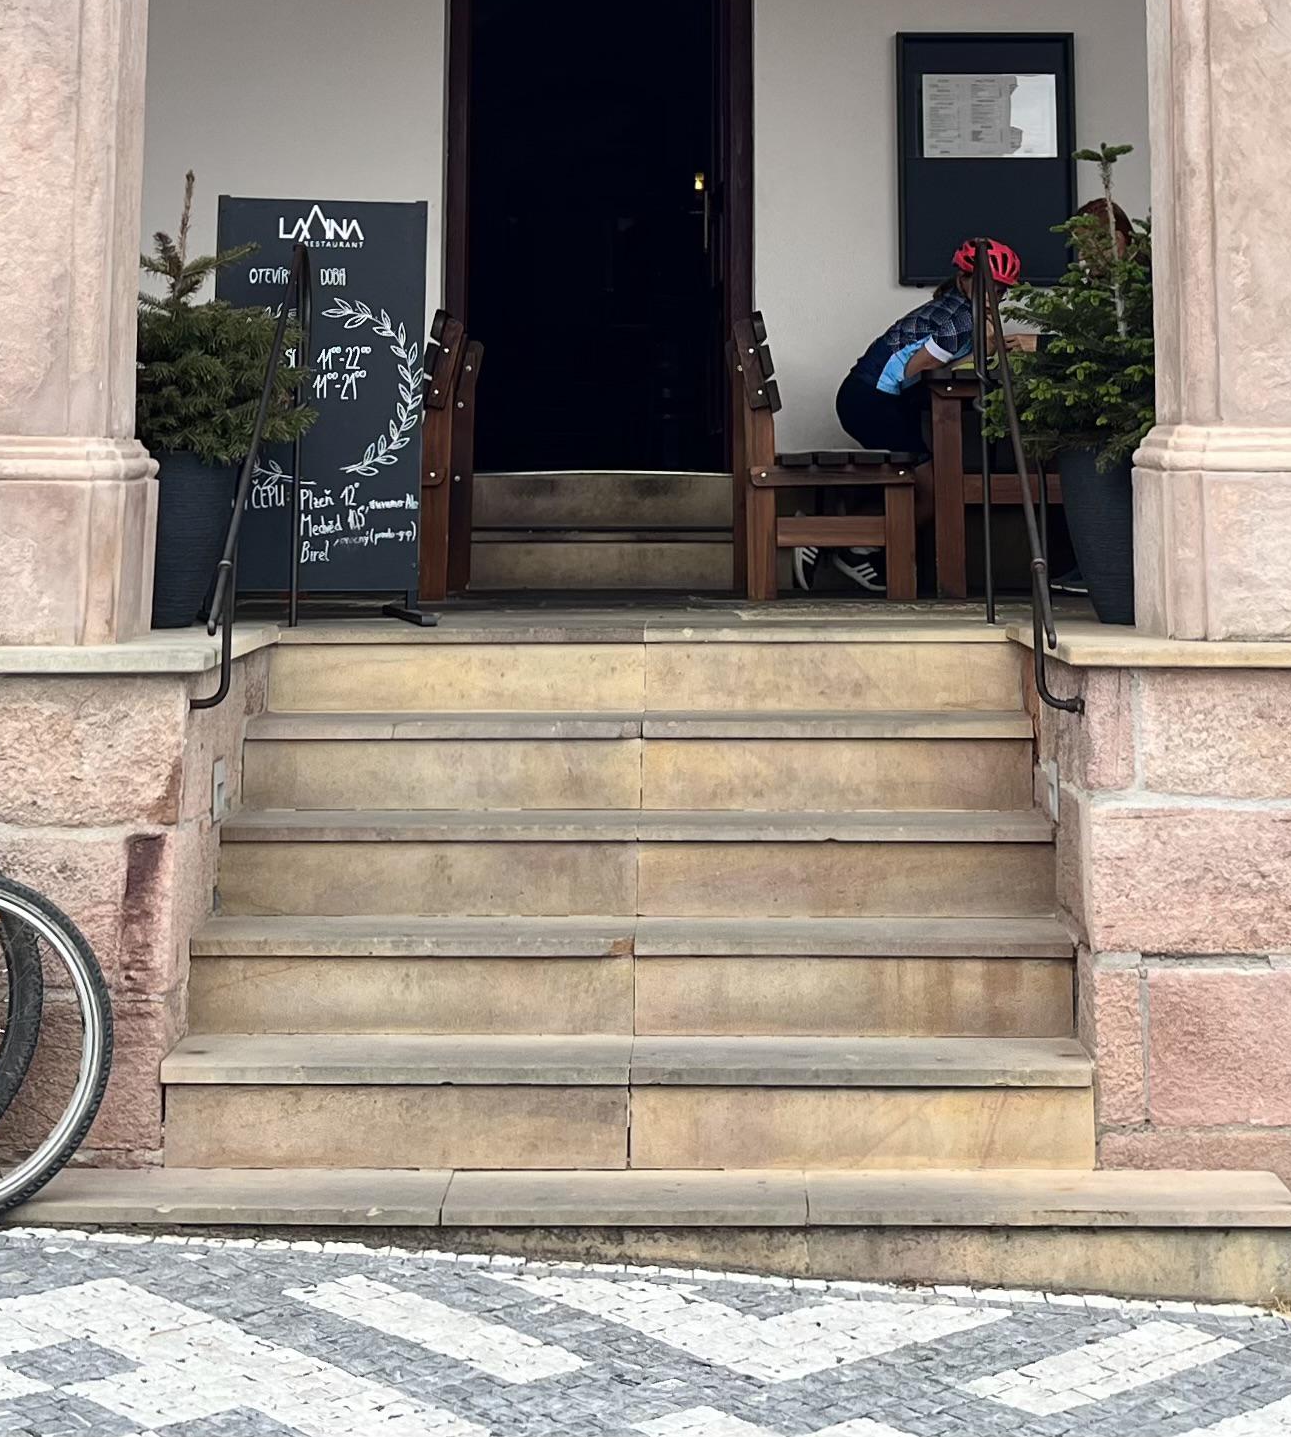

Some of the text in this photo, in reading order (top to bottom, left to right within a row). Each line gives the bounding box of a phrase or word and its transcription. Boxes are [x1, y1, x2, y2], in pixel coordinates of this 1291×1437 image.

[320, 267, 347, 286] DOBA
[300, 487, 335, 511] Plzeň
[299, 539, 330, 564] Birel
